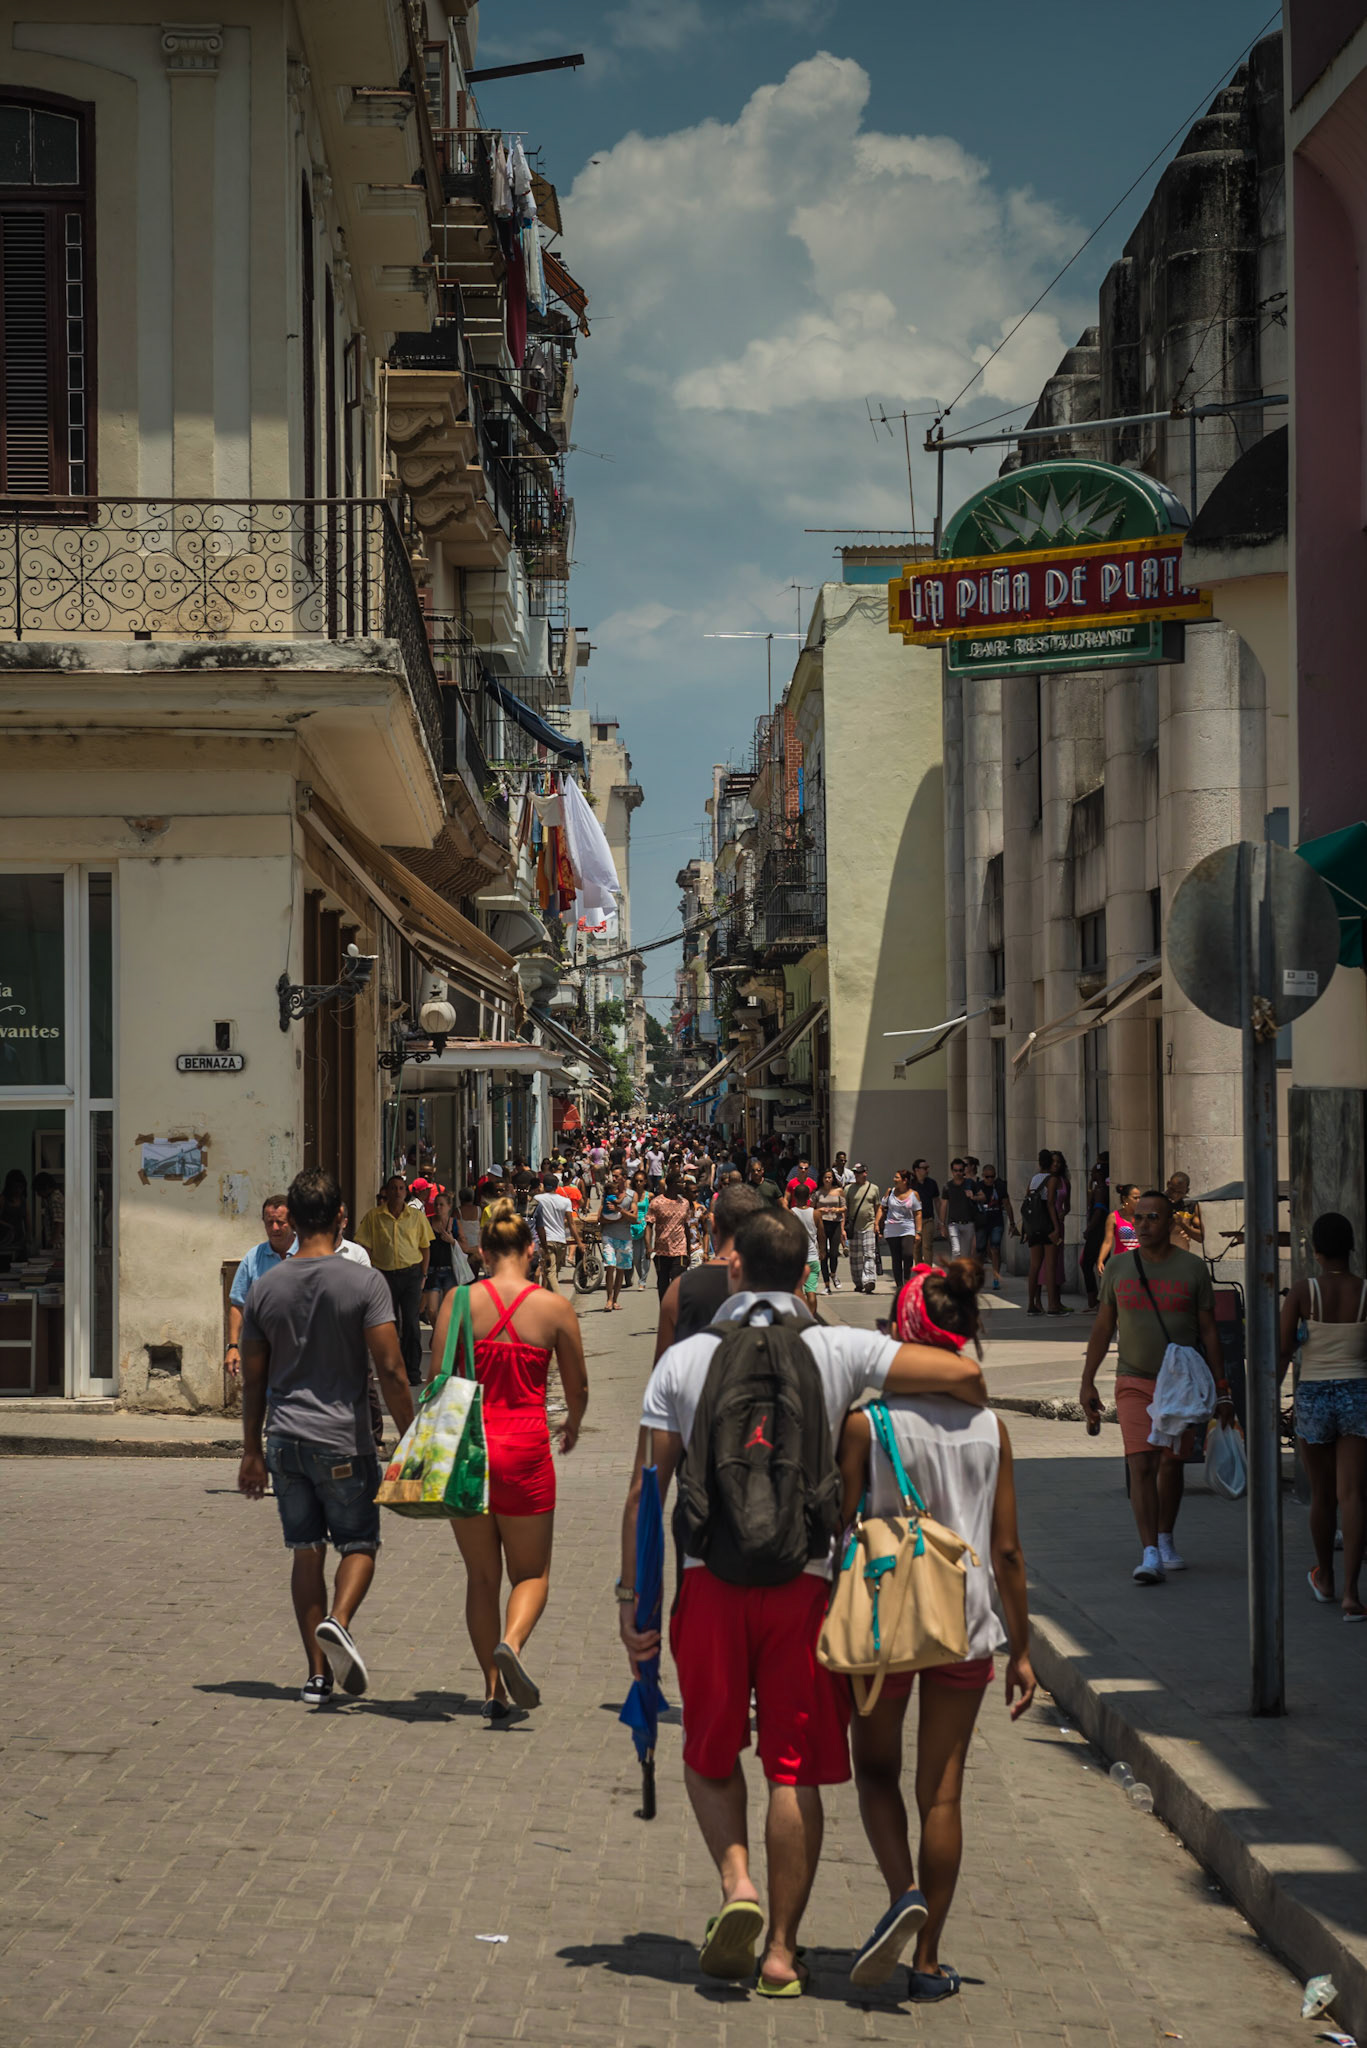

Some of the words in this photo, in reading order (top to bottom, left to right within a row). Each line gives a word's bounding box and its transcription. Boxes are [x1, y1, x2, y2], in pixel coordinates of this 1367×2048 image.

[910, 575, 944, 626] LA
[956, 567, 1030, 617] PIÑA
[1045, 566, 1087, 608] DE
[1014, 628, 1135, 655] RESTAURANT
[184, 1057, 236, 1069] BERNAZA
[1116, 1279, 1192, 1297] JOURNAL
